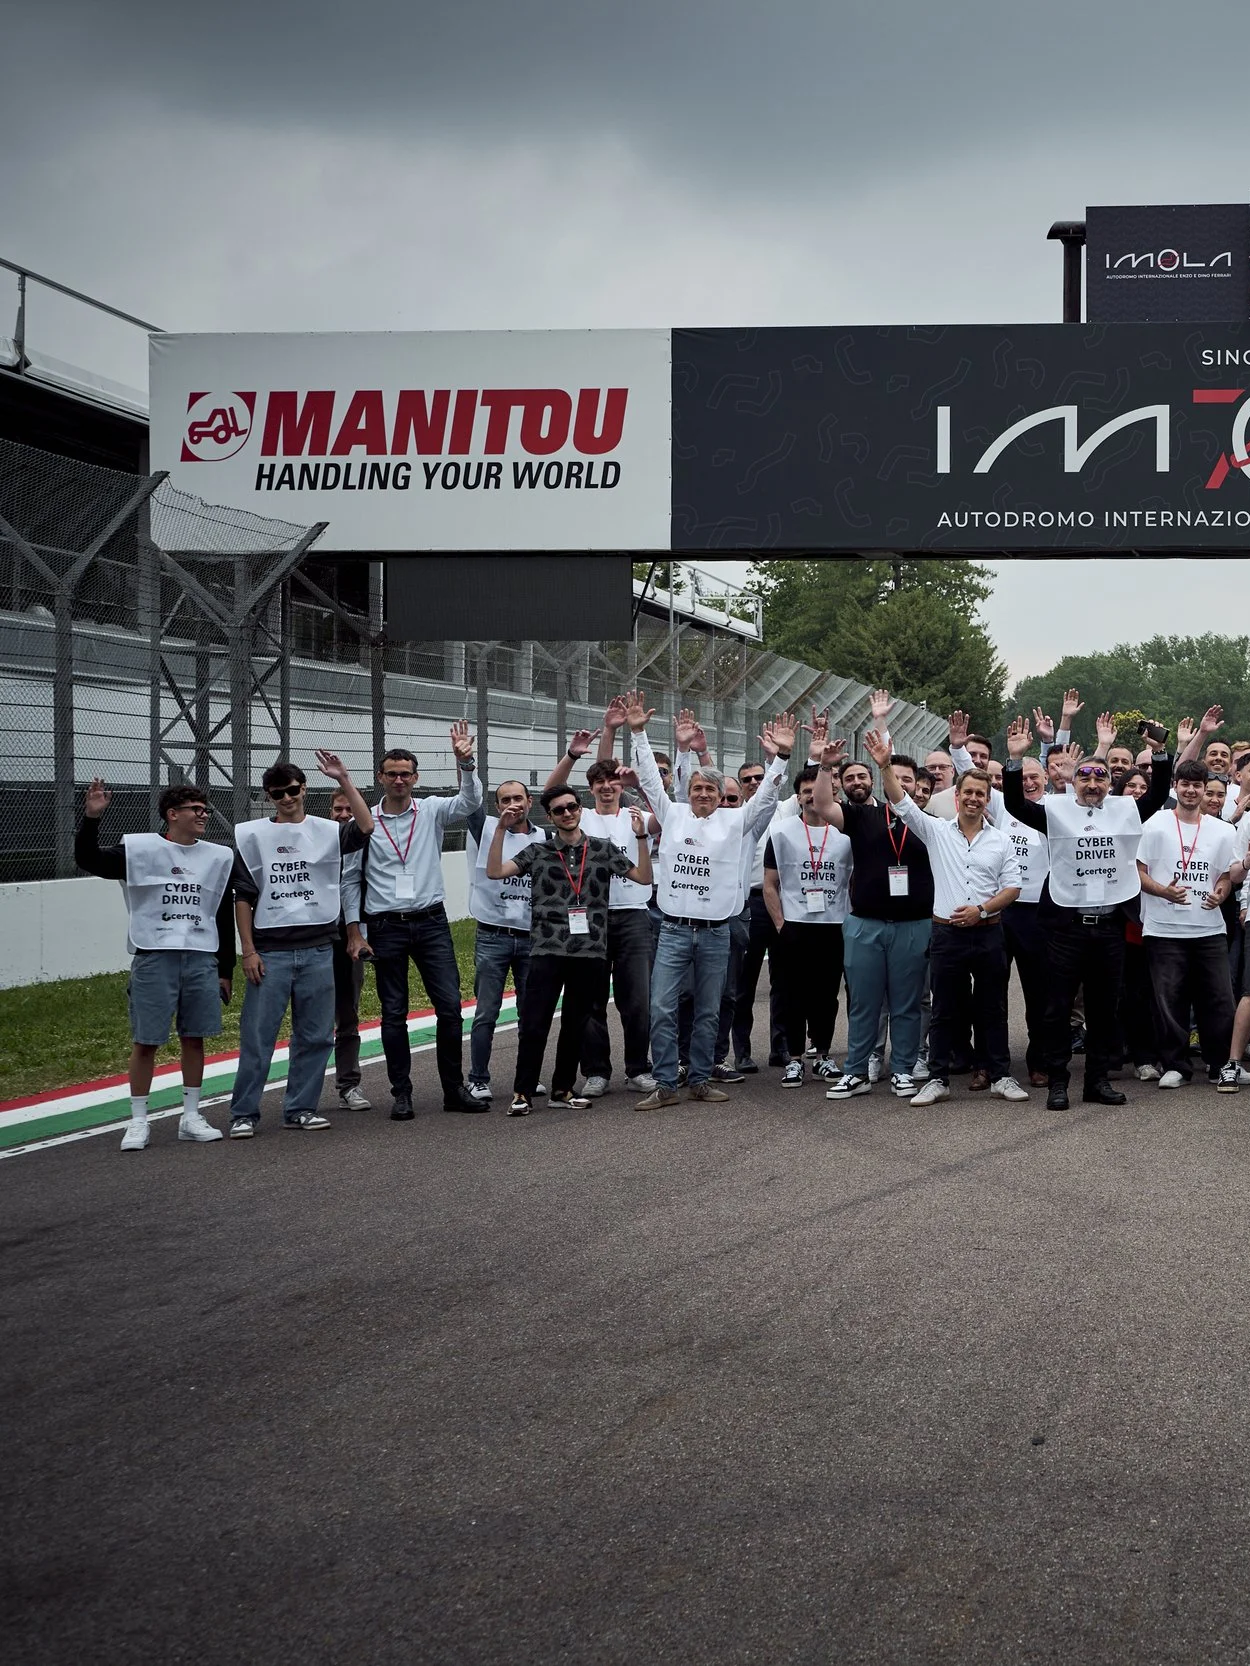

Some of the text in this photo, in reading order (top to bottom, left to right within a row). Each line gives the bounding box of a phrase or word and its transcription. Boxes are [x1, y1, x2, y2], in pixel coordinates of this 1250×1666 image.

[1105, 248, 1232, 272] IMOLA
[260, 387, 629, 457] MANITOU
[254, 460, 622, 491] HANDLING YOUR WORLD
[937, 511, 1095, 528] AUTODROMO
[1077, 837, 1114, 848] CYBER
[677, 853, 710, 865] CYBER
[1075, 849, 1116, 860] DRIVER
[271, 860, 307, 872] CYBER
[673, 864, 711, 877] DRIVER
[269, 872, 311, 884] DRIVER
[800, 871, 836, 882] DRIVER
[1084, 867, 1117, 879] certego
[165, 883, 202, 894] CYBER
[503, 877, 532, 888] DRIVE
[678, 882, 710, 896] certego
[280, 890, 315, 901] certego
